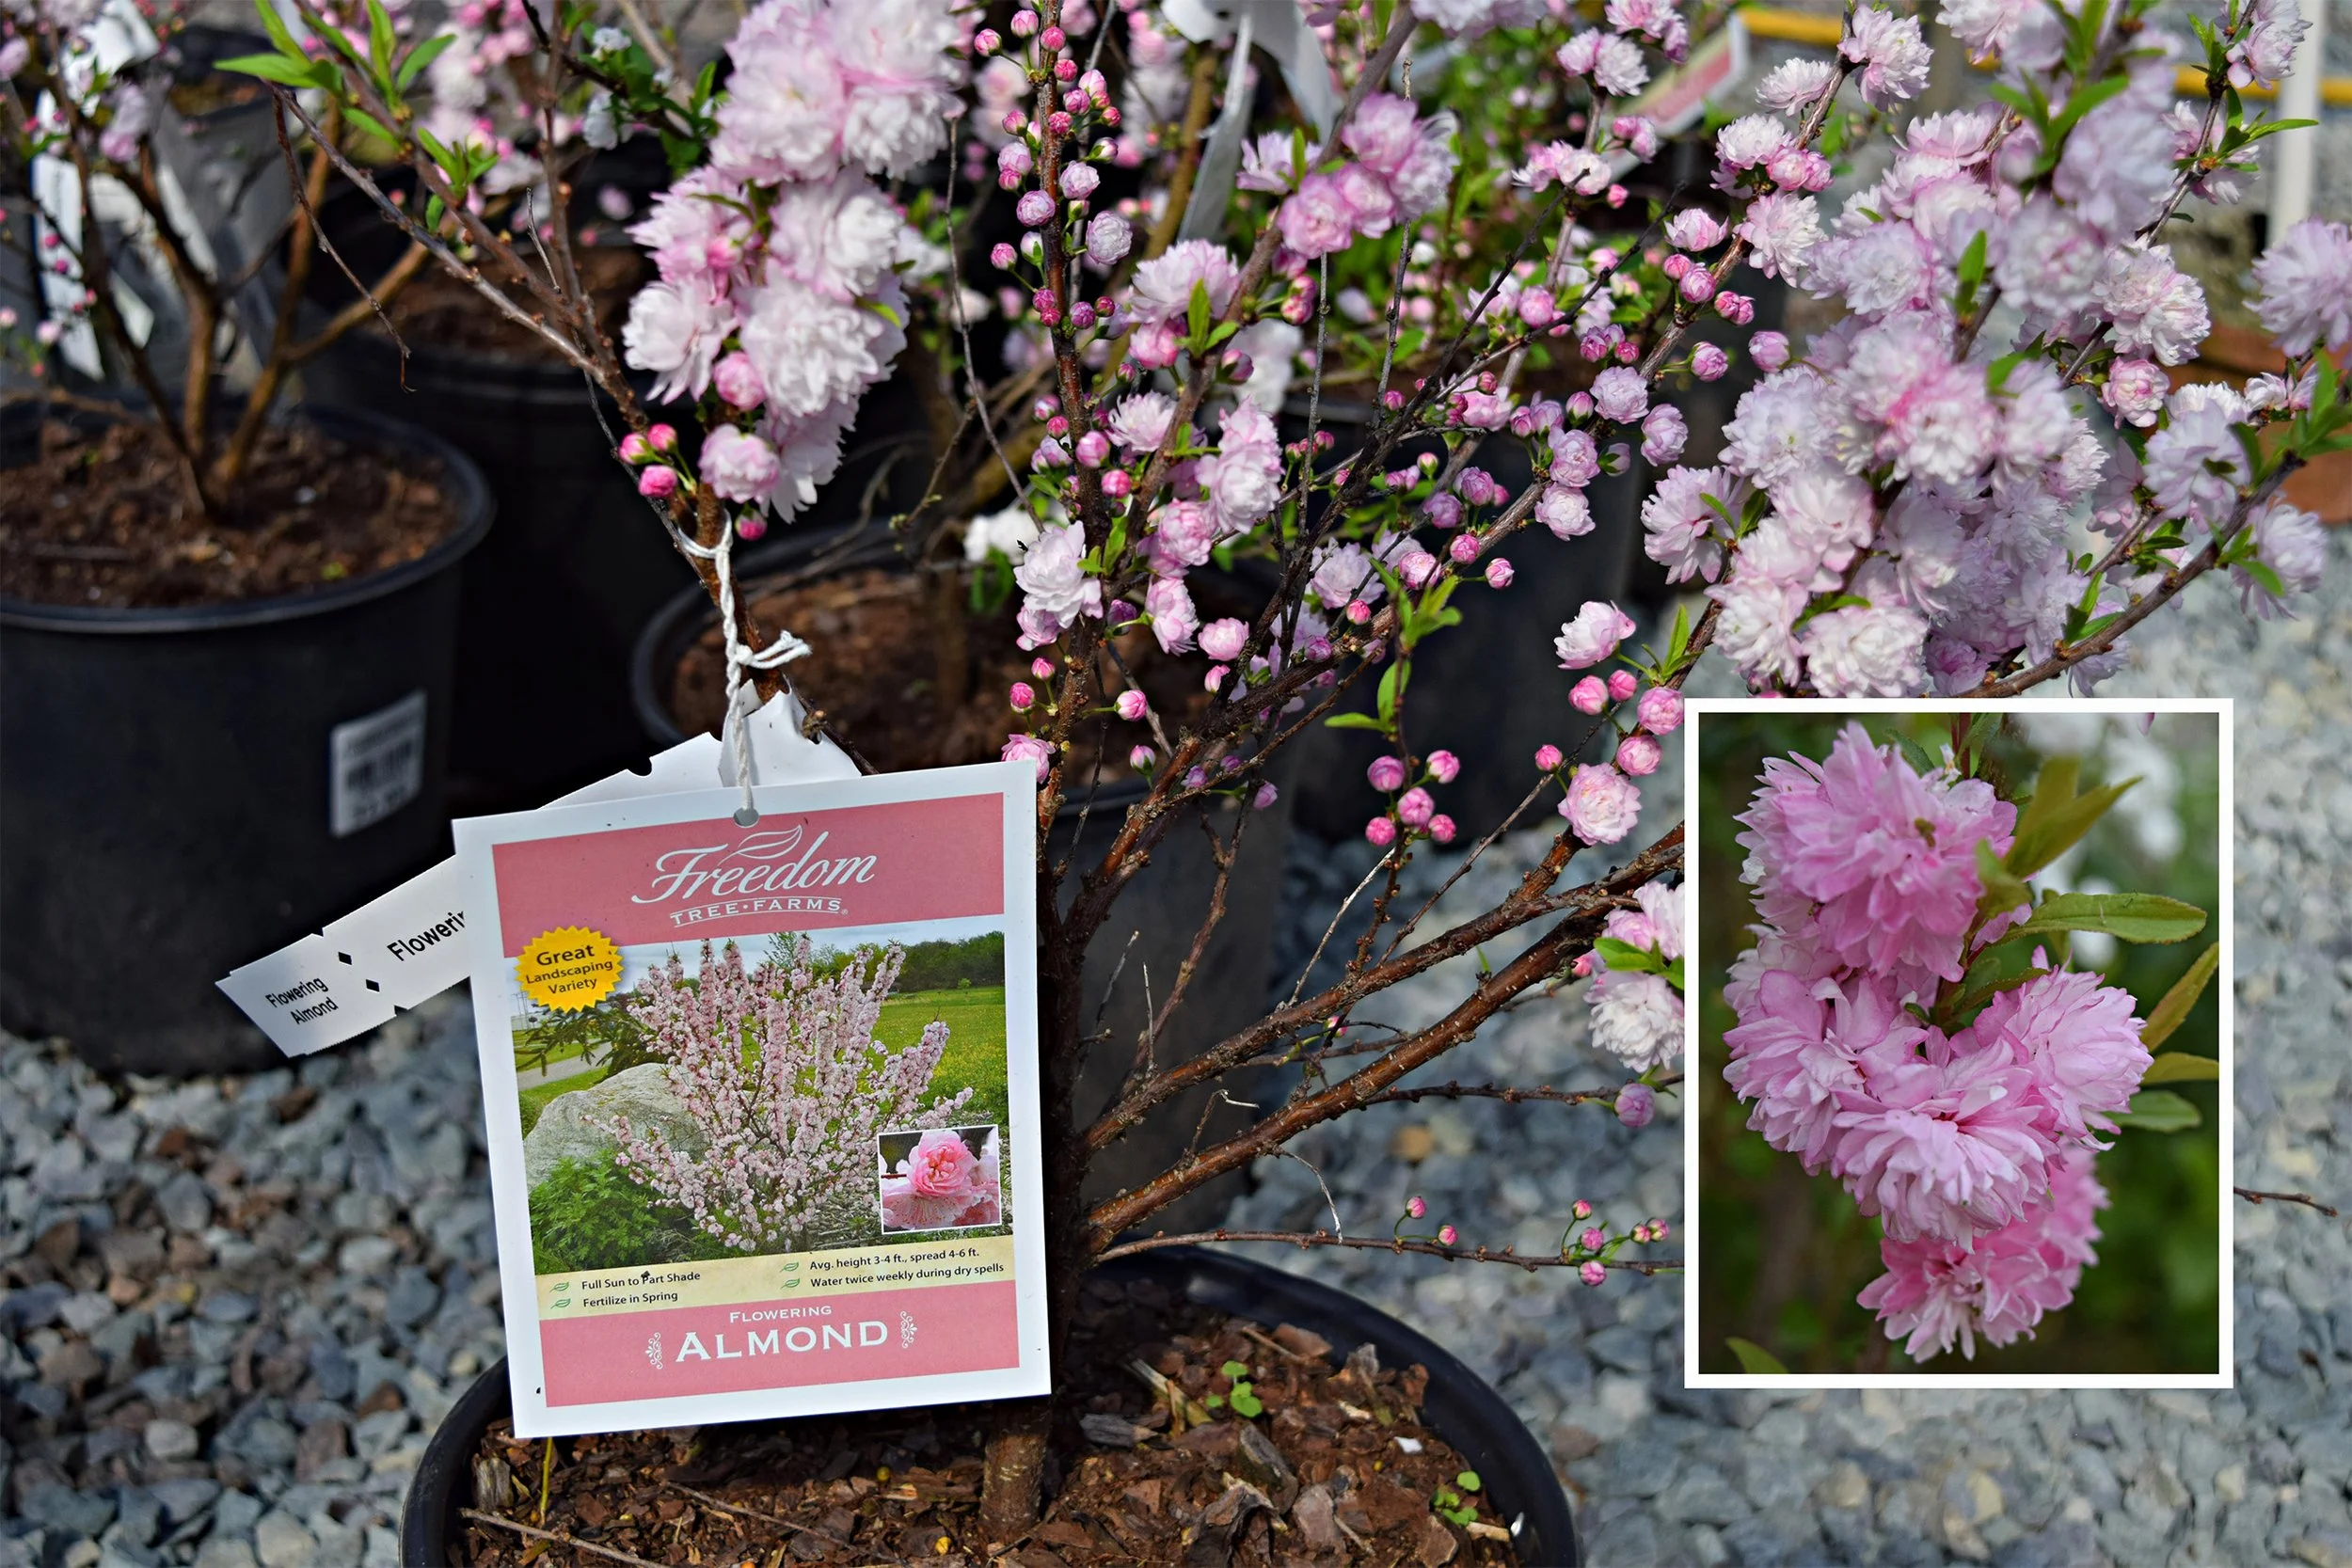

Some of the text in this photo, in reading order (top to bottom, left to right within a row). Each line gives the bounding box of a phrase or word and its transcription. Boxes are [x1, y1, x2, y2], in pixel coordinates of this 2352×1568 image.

[631, 831, 877, 904] Freedom
[536, 944, 596, 966] Great
[526, 960, 613, 984] Landscaping
[264, 977, 329, 1008] Flowering
[548, 978, 597, 994] Variety
[290, 996, 339, 1025] Almond
[809, 1259, 834, 1272] Avg.
[836, 1254, 871, 1270] height
[874, 1254, 891, 1265] 3-4
[910, 1247, 946, 1262] spread
[948, 1247, 966, 1259] 4-6
[968, 1247, 979, 1257] ft.
[581, 1271, 701, 1290] Full Sun to Part Shade
[810, 1262, 1004, 1288] Water twice weekly during dry spells
[583, 1291, 678, 1307] Fertilize in Spring
[729, 1305, 833, 1323] FLOWERING
[675, 1320, 888, 1362] ALMOND
